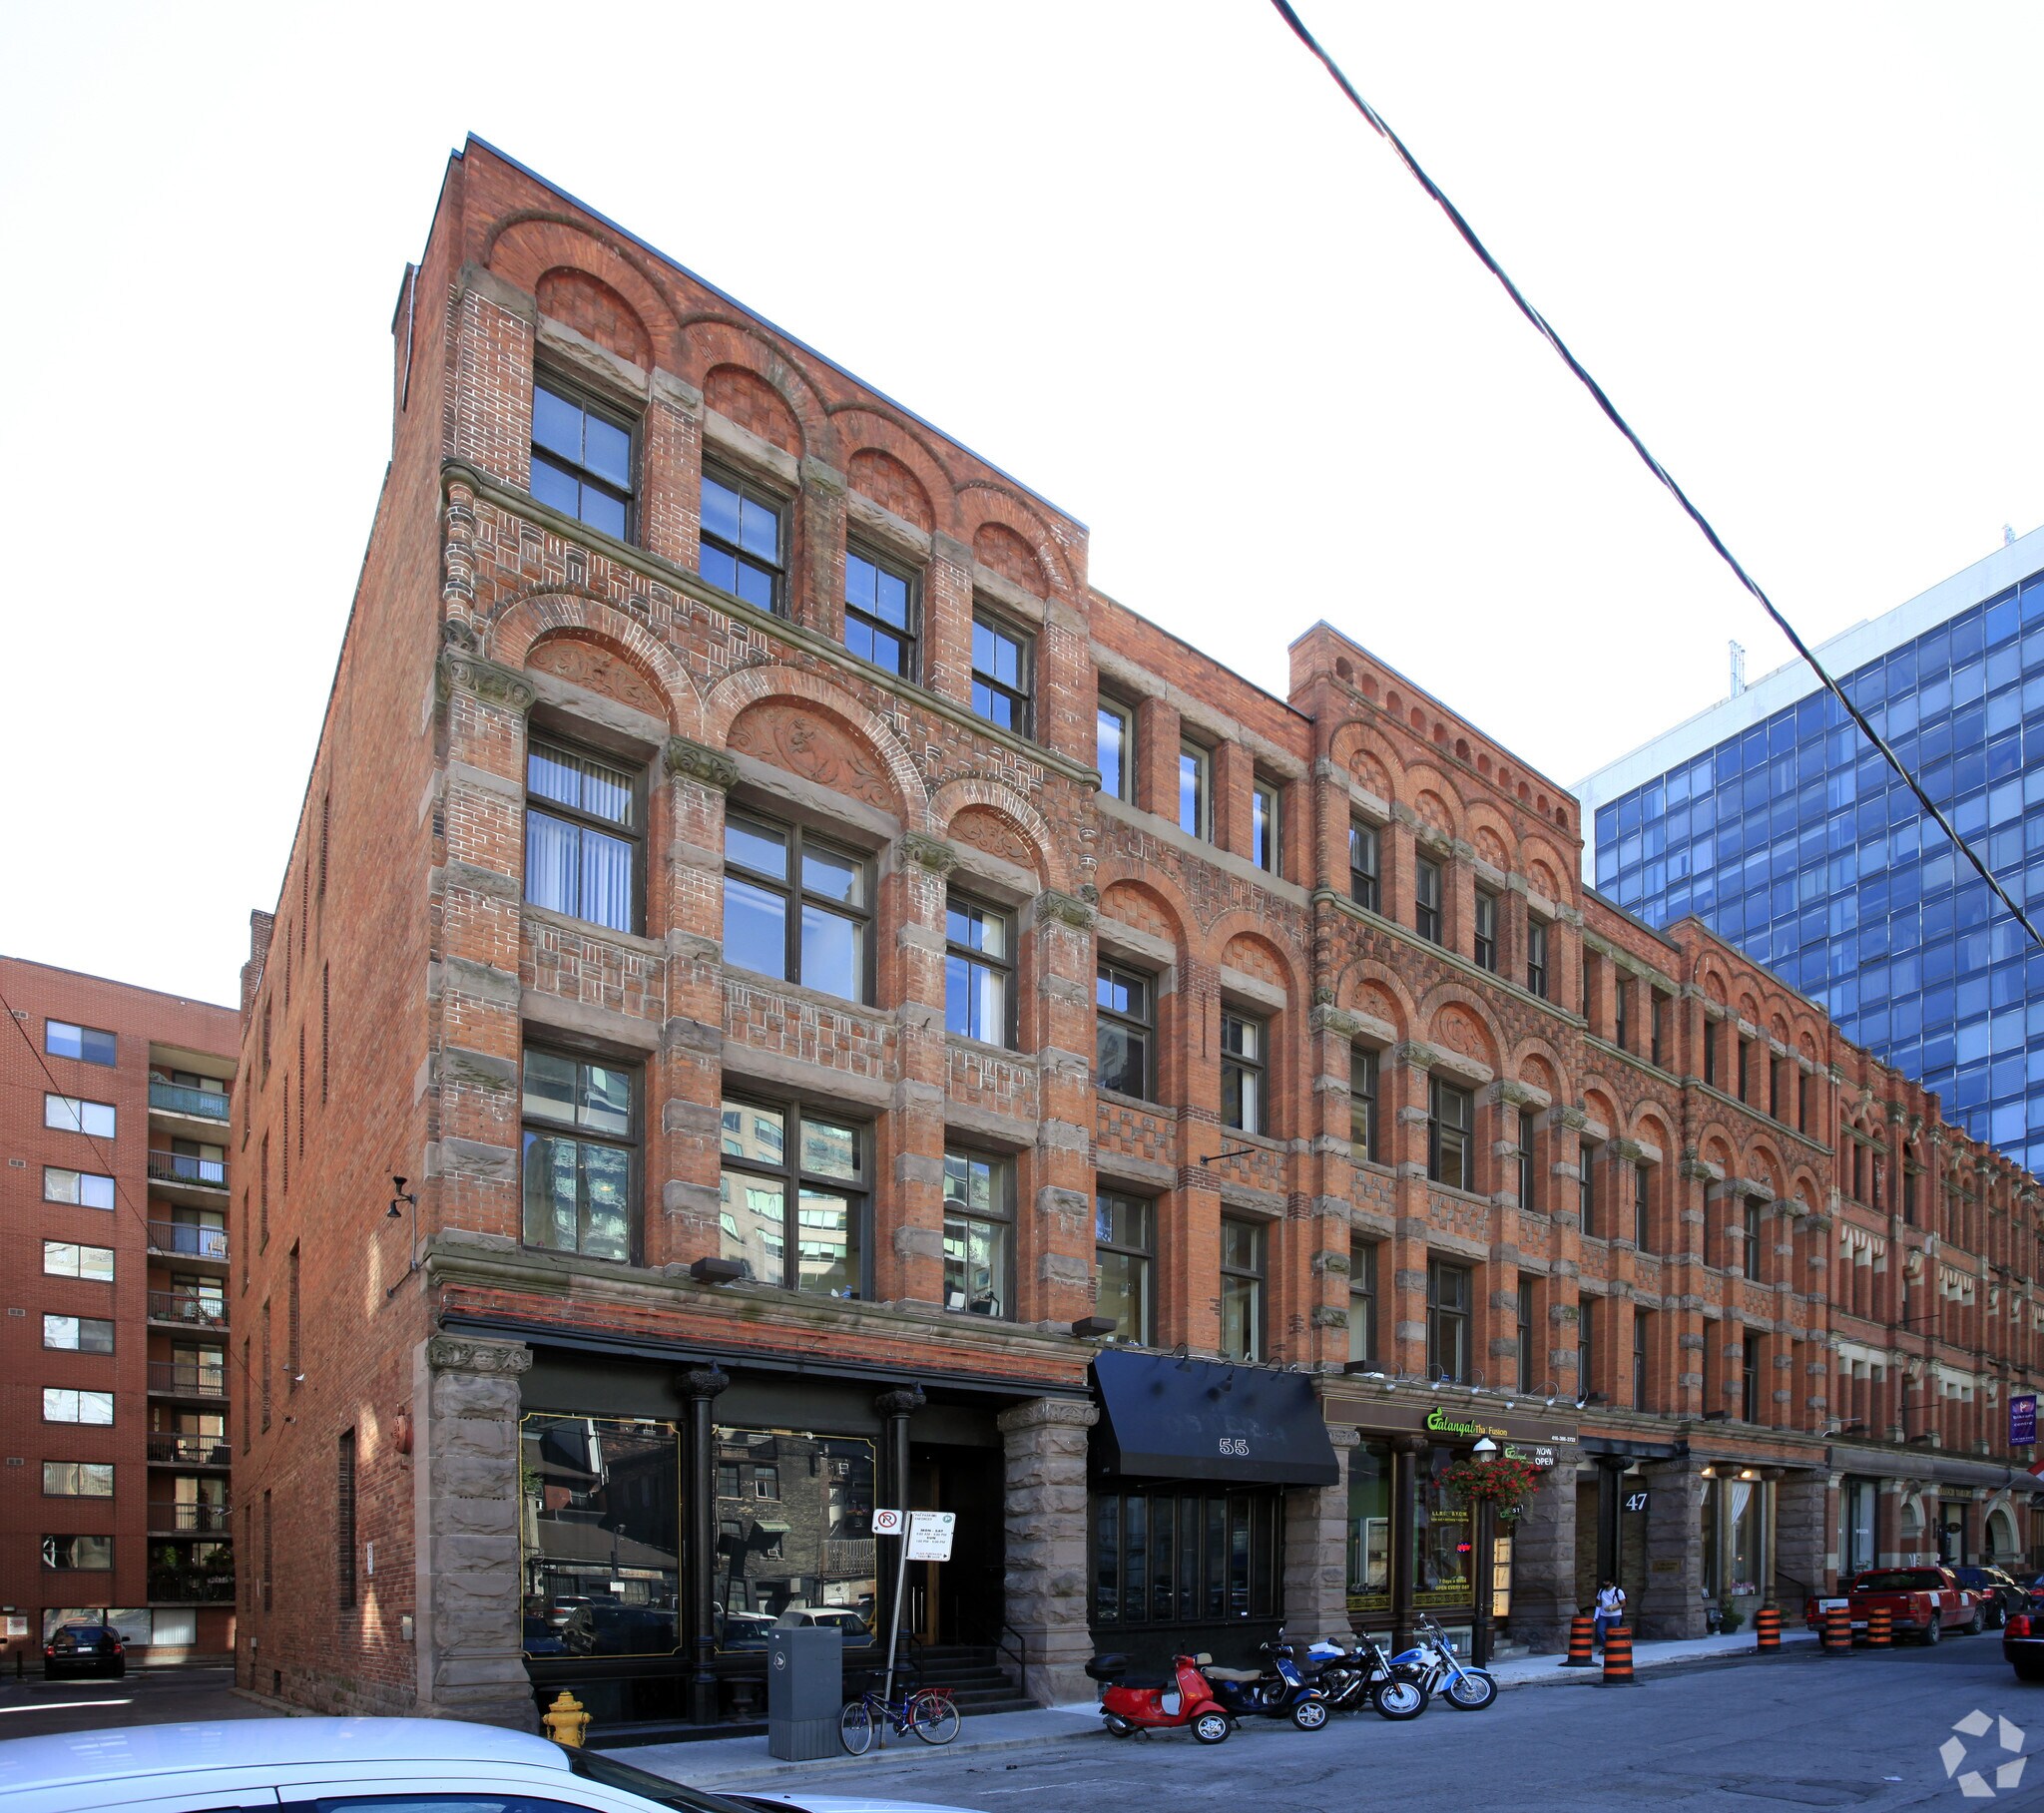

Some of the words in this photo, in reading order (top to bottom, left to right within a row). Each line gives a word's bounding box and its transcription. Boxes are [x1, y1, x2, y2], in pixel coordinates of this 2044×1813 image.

[1427, 1406, 1475, 1437] Galangal
[1488, 1426, 1508, 1437] Fusion
[1219, 1438, 1250, 1456] 55
[1535, 1447, 1553, 1456] NOW
[1535, 1457, 1554, 1466] OPEN
[1626, 1493, 1648, 1511] 47
